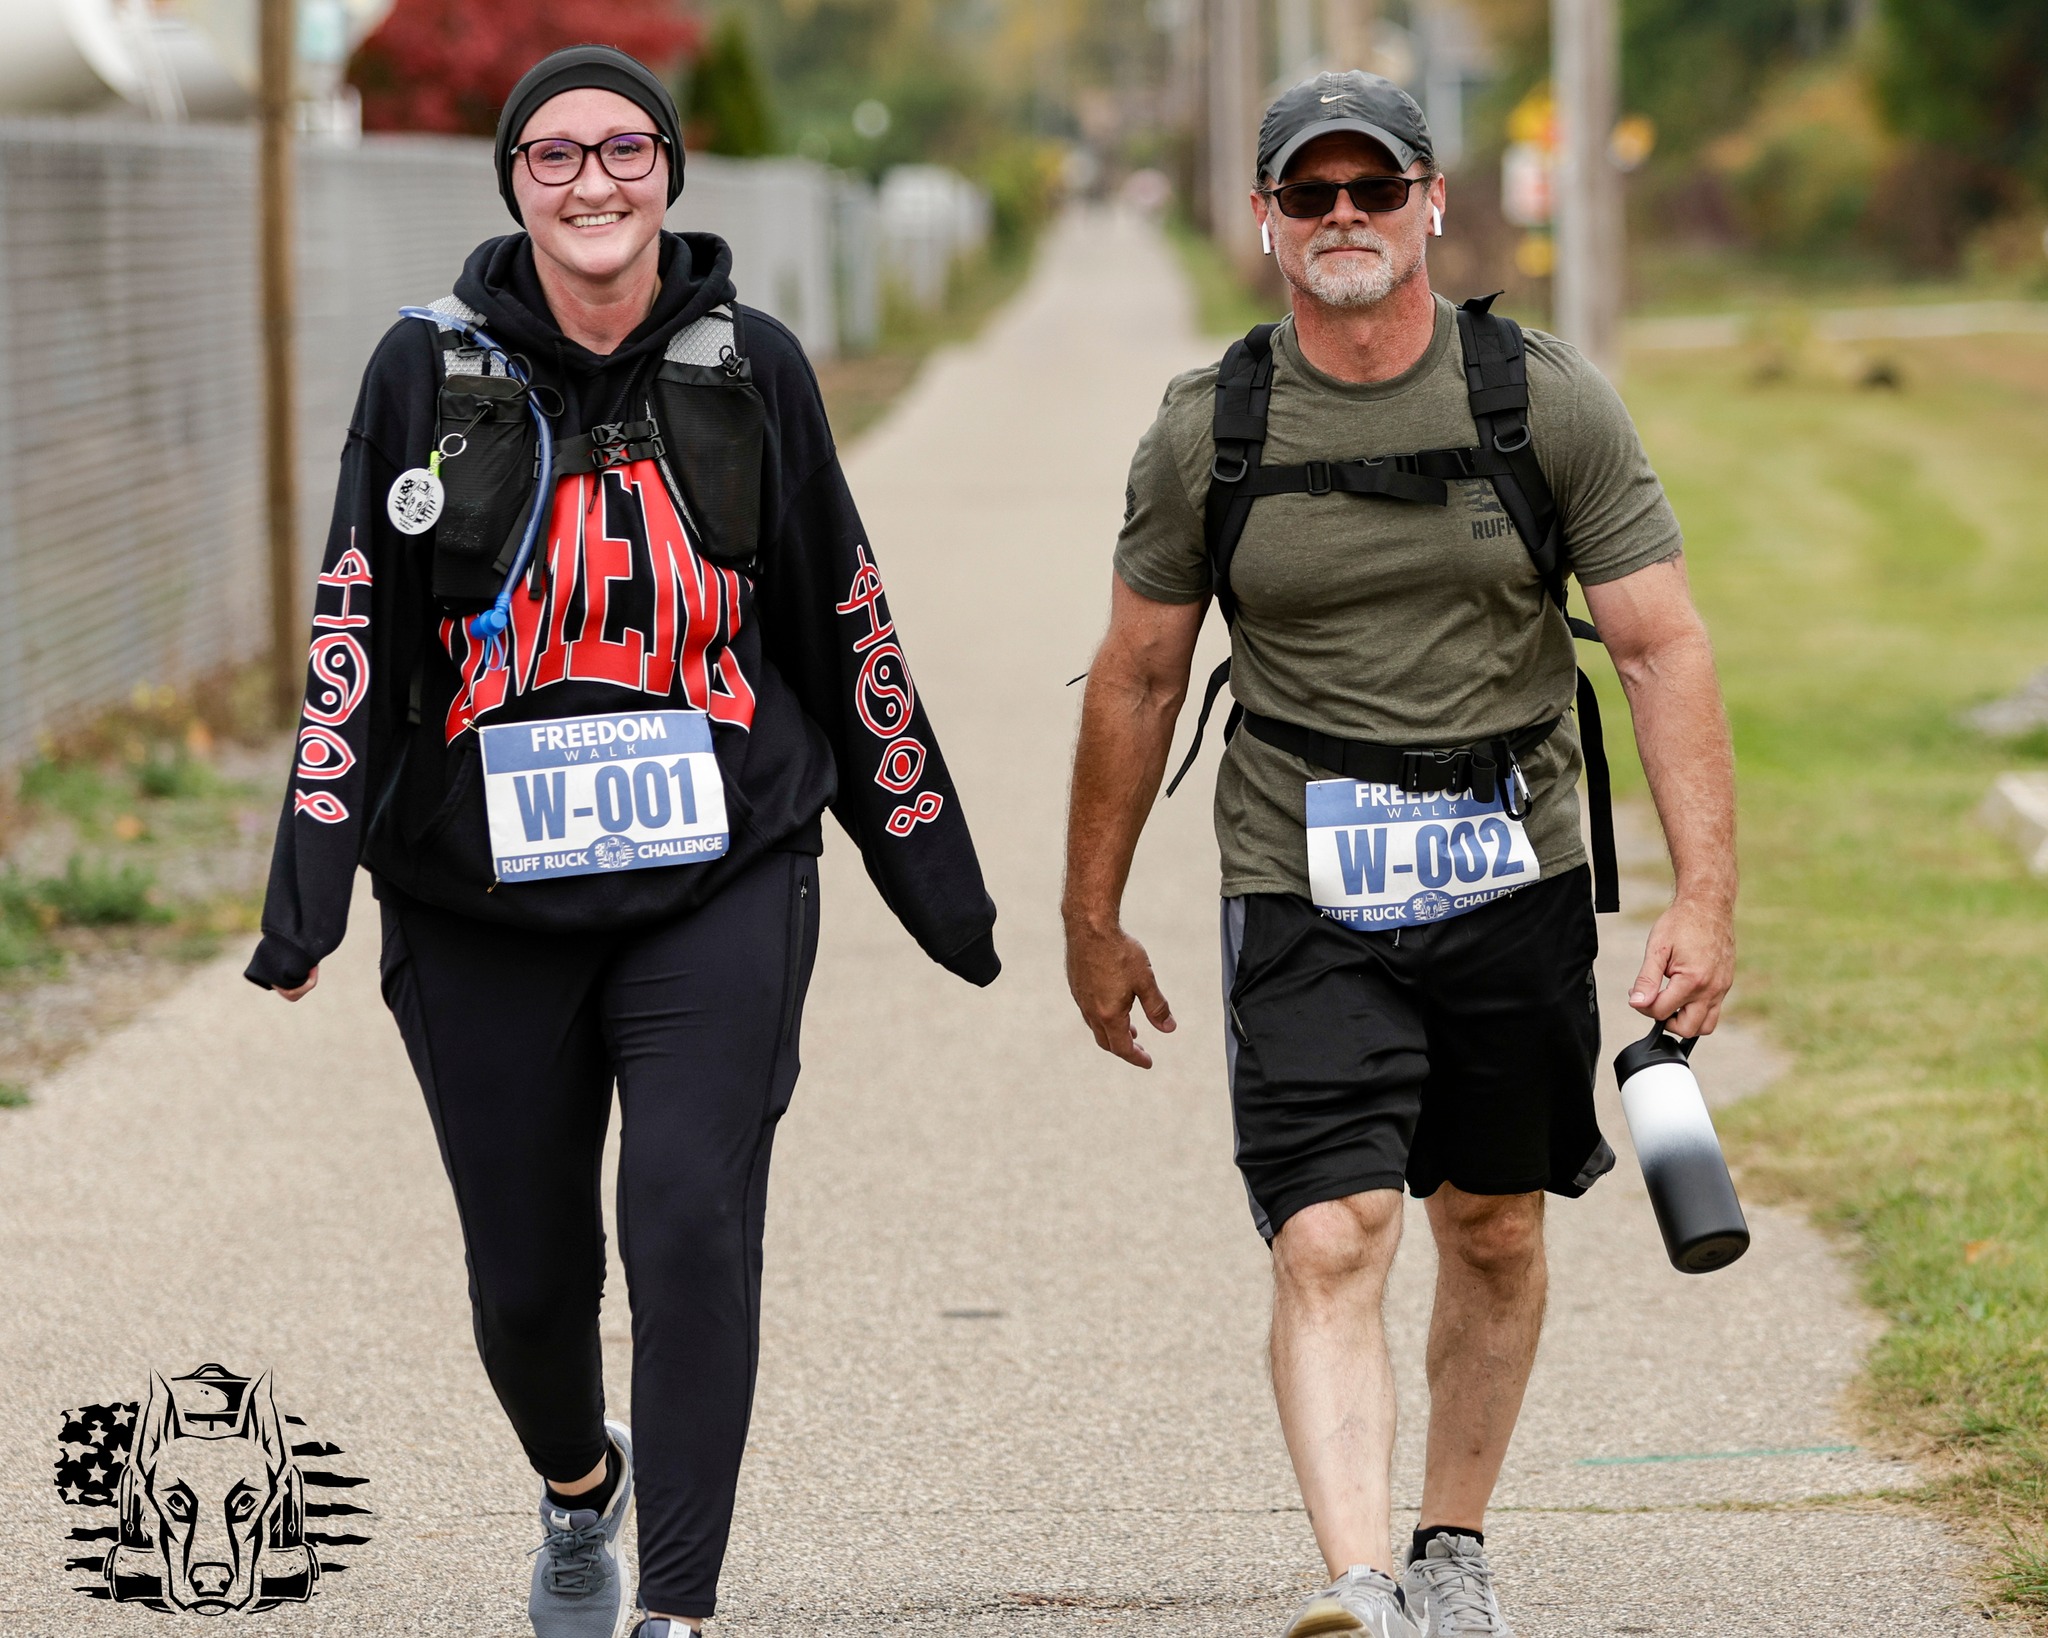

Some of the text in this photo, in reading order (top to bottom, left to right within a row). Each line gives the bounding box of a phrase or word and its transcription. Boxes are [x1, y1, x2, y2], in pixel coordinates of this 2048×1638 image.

[531, 716, 667, 752] FREEDOM
[564, 743, 637, 762] WALK
[513, 758, 698, 842] W-001
[1355, 783, 1474, 807] FREEDO
[1387, 804, 1457, 818] WALK
[501, 836, 723, 874] RUFF RUCK CHALLENGE
[1335, 817, 1525, 896] W-002
[1321, 882, 1534, 922] RUFF RUCK CHALLEN
